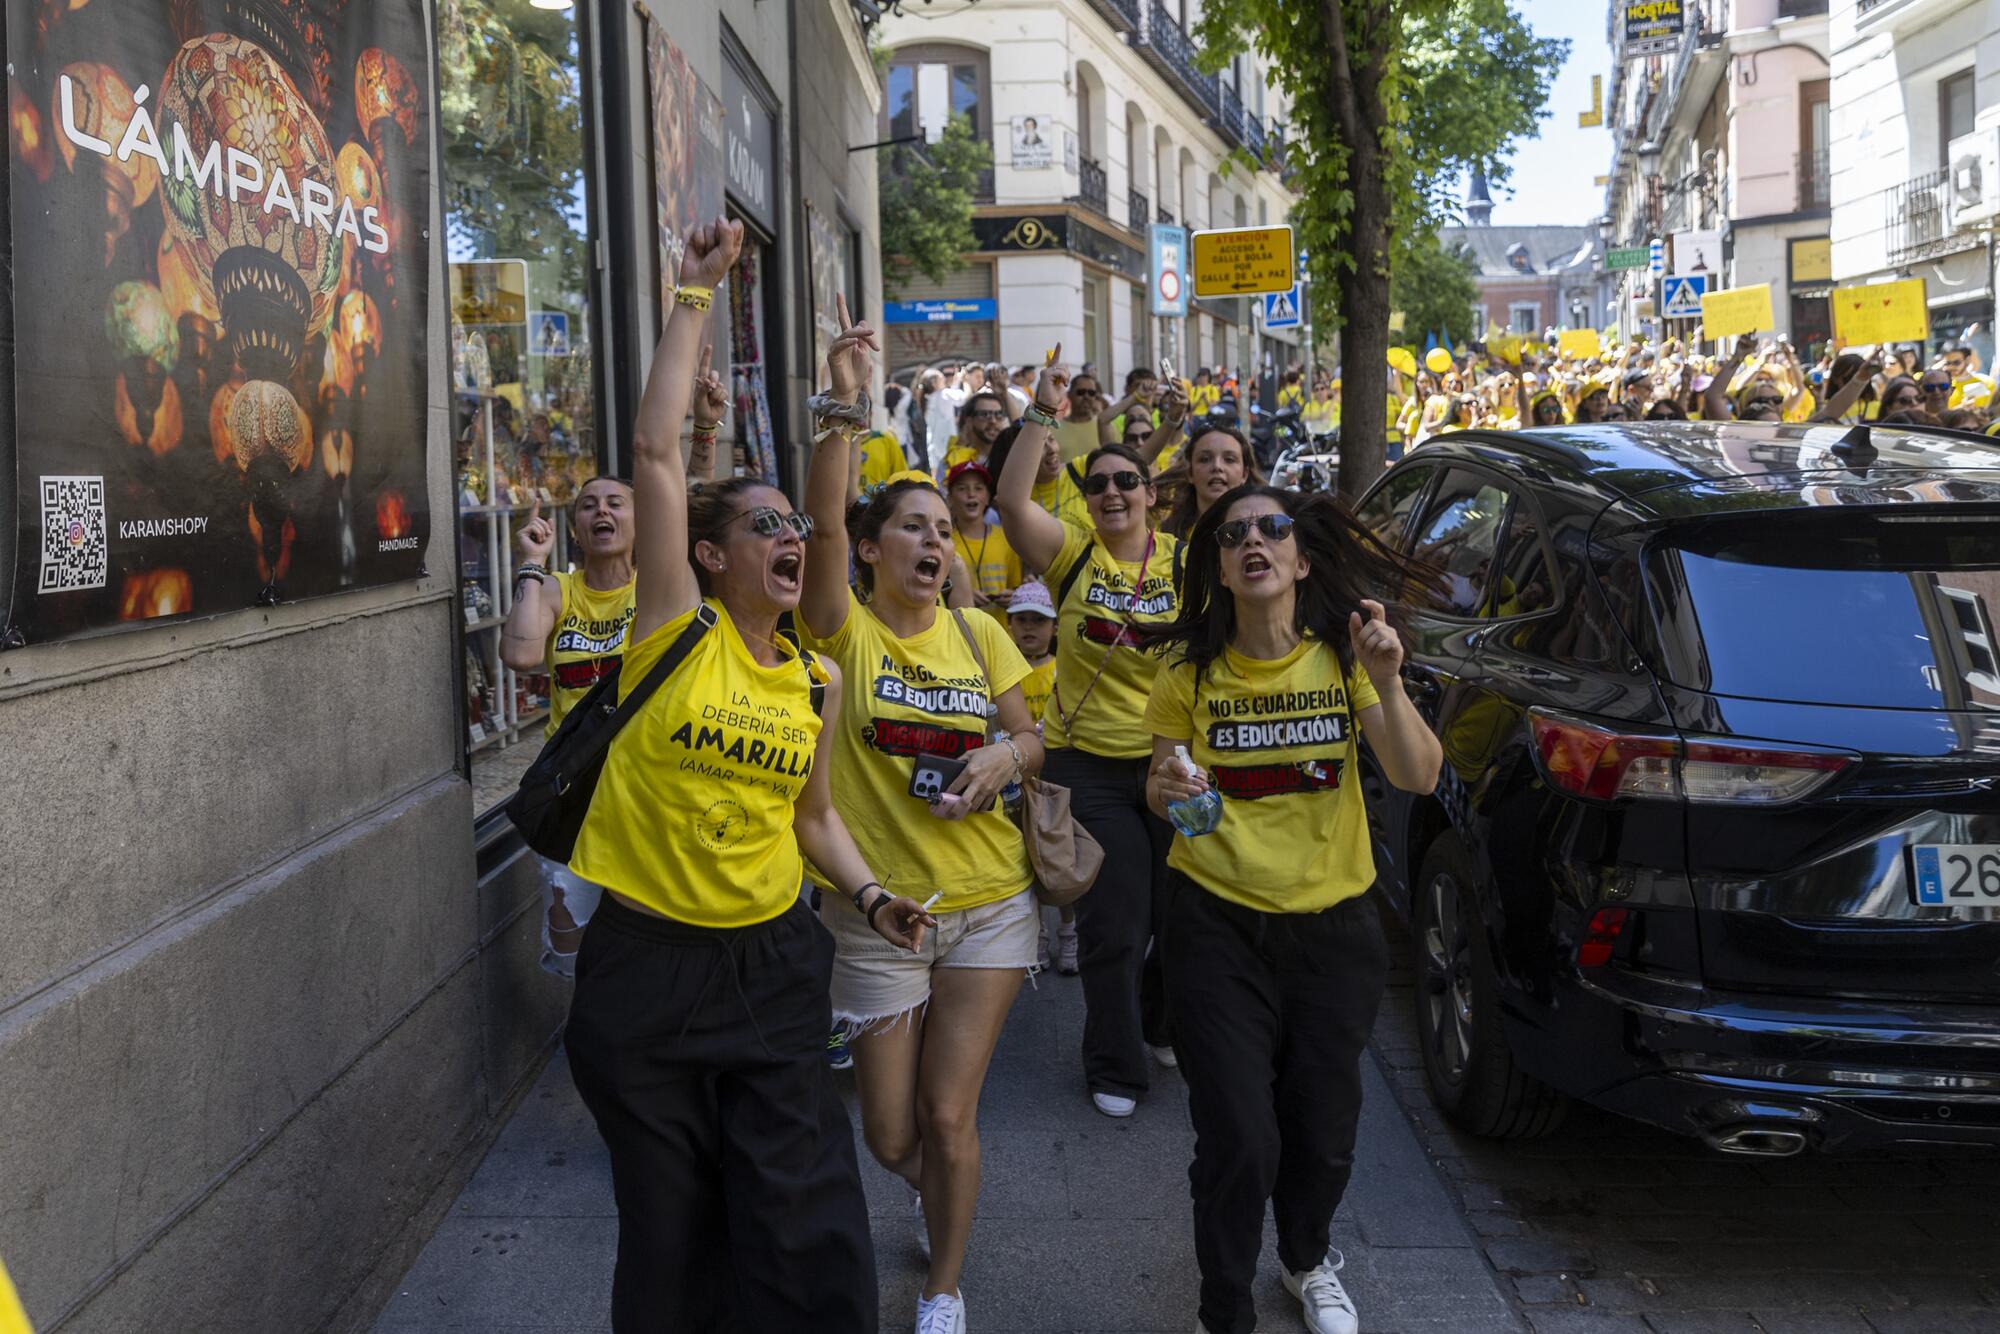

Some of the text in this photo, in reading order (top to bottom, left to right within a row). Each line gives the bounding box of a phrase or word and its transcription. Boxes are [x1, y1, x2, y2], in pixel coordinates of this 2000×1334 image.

[1628, 1, 1681, 20] HOSTAL
[60, 73, 389, 254] LÁMPARAS
[1022, 222, 1038, 243] 9
[1215, 232, 1270, 244] ATENCIÓN
[1212, 252, 1273, 263] CALLE BOLSA
[1219, 243, 1265, 253] ACCESO A
[1201, 269, 1286, 282] CALLE DE LA PAZ
[1234, 262, 1252, 271] POR
[119, 516, 209, 539] KARAMSHOPY
[378, 536, 419, 552] HANDMADE
[1088, 587, 1105, 602] ES
[578, 618, 588, 632] ES
[557, 634, 571, 650] ES
[902, 664, 917, 681] ES
[732, 690, 750, 709] LA
[882, 679, 988, 718] ES EDUCACIÓN
[1208, 684, 1346, 718] NO ES GUARDERÍA
[702, 704, 808, 745] DEBERÍA SER
[1215, 715, 1342, 748] ES EDUCACIÓN
[878, 720, 959, 753] DIGNIDAD
[669, 721, 812, 780] AMARILLA
[679, 756, 735, 781] (AMAR
[1947, 854, 2000, 898] 26
[1925, 881, 1937, 894] E
